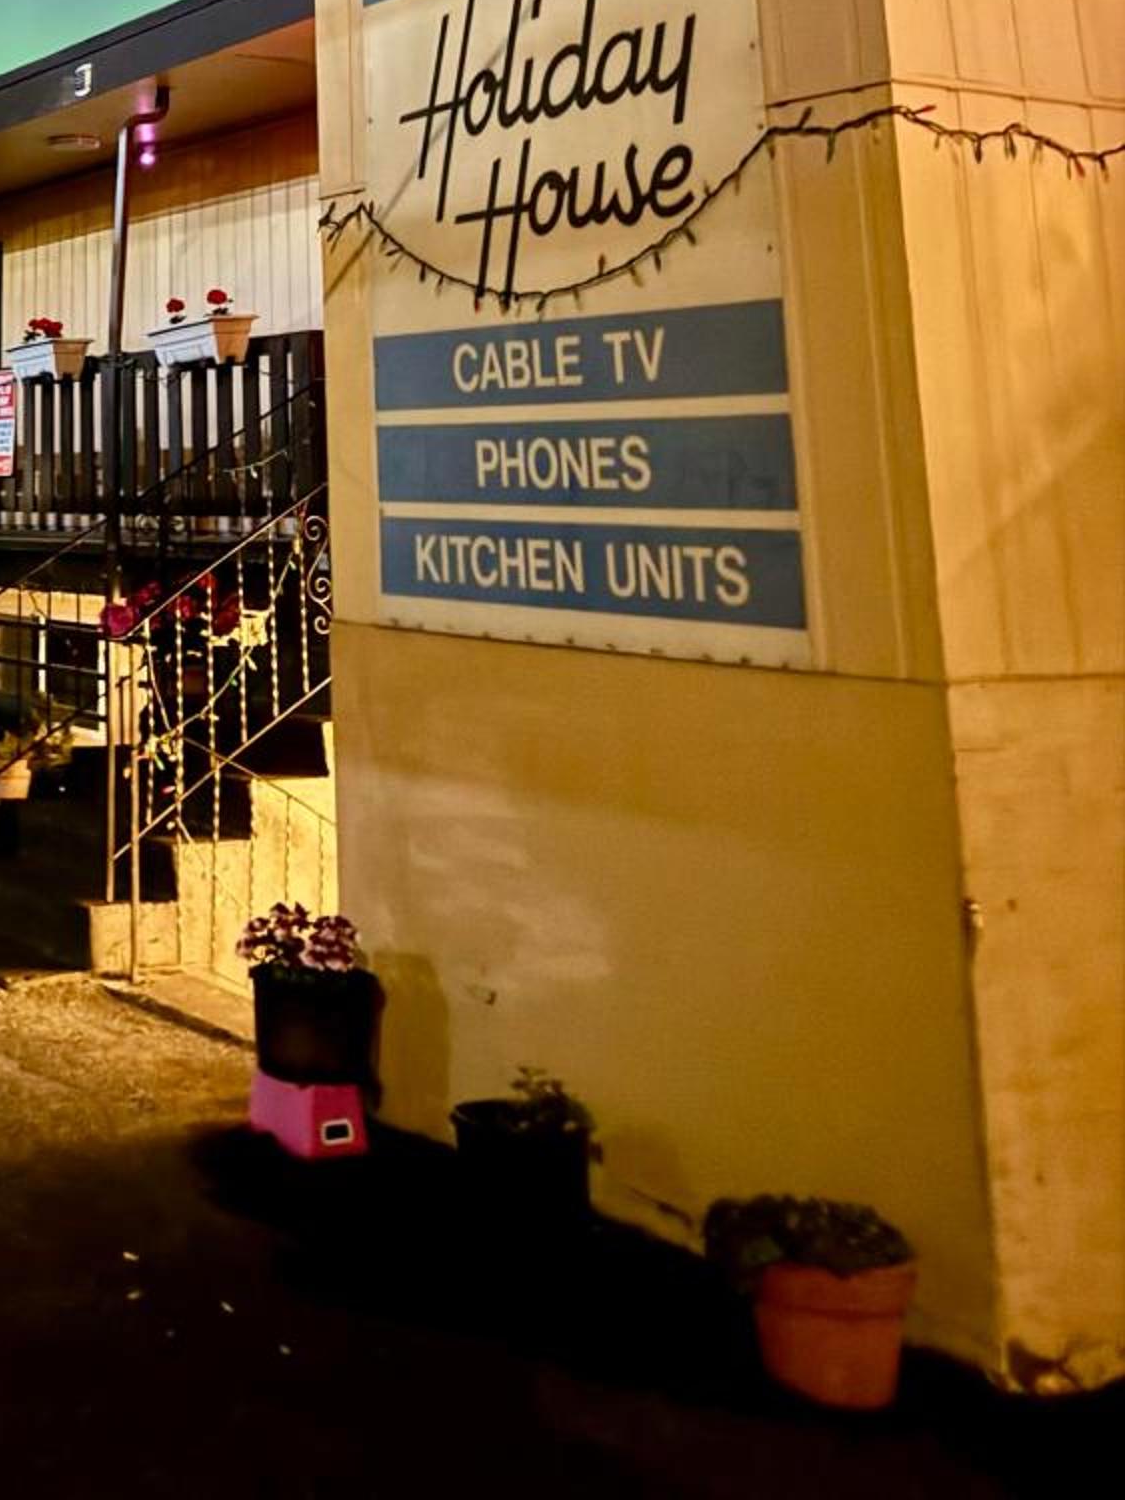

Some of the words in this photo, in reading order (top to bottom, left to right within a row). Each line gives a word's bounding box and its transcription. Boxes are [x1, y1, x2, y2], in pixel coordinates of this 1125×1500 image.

[454, 138, 694, 308] House
[452, 336, 583, 393] CABLE
[602, 327, 665, 384] TV
[475, 434, 652, 493] PHONES
[415, 533, 586, 594] KITCHEN
[605, 543, 751, 608] UNITS
